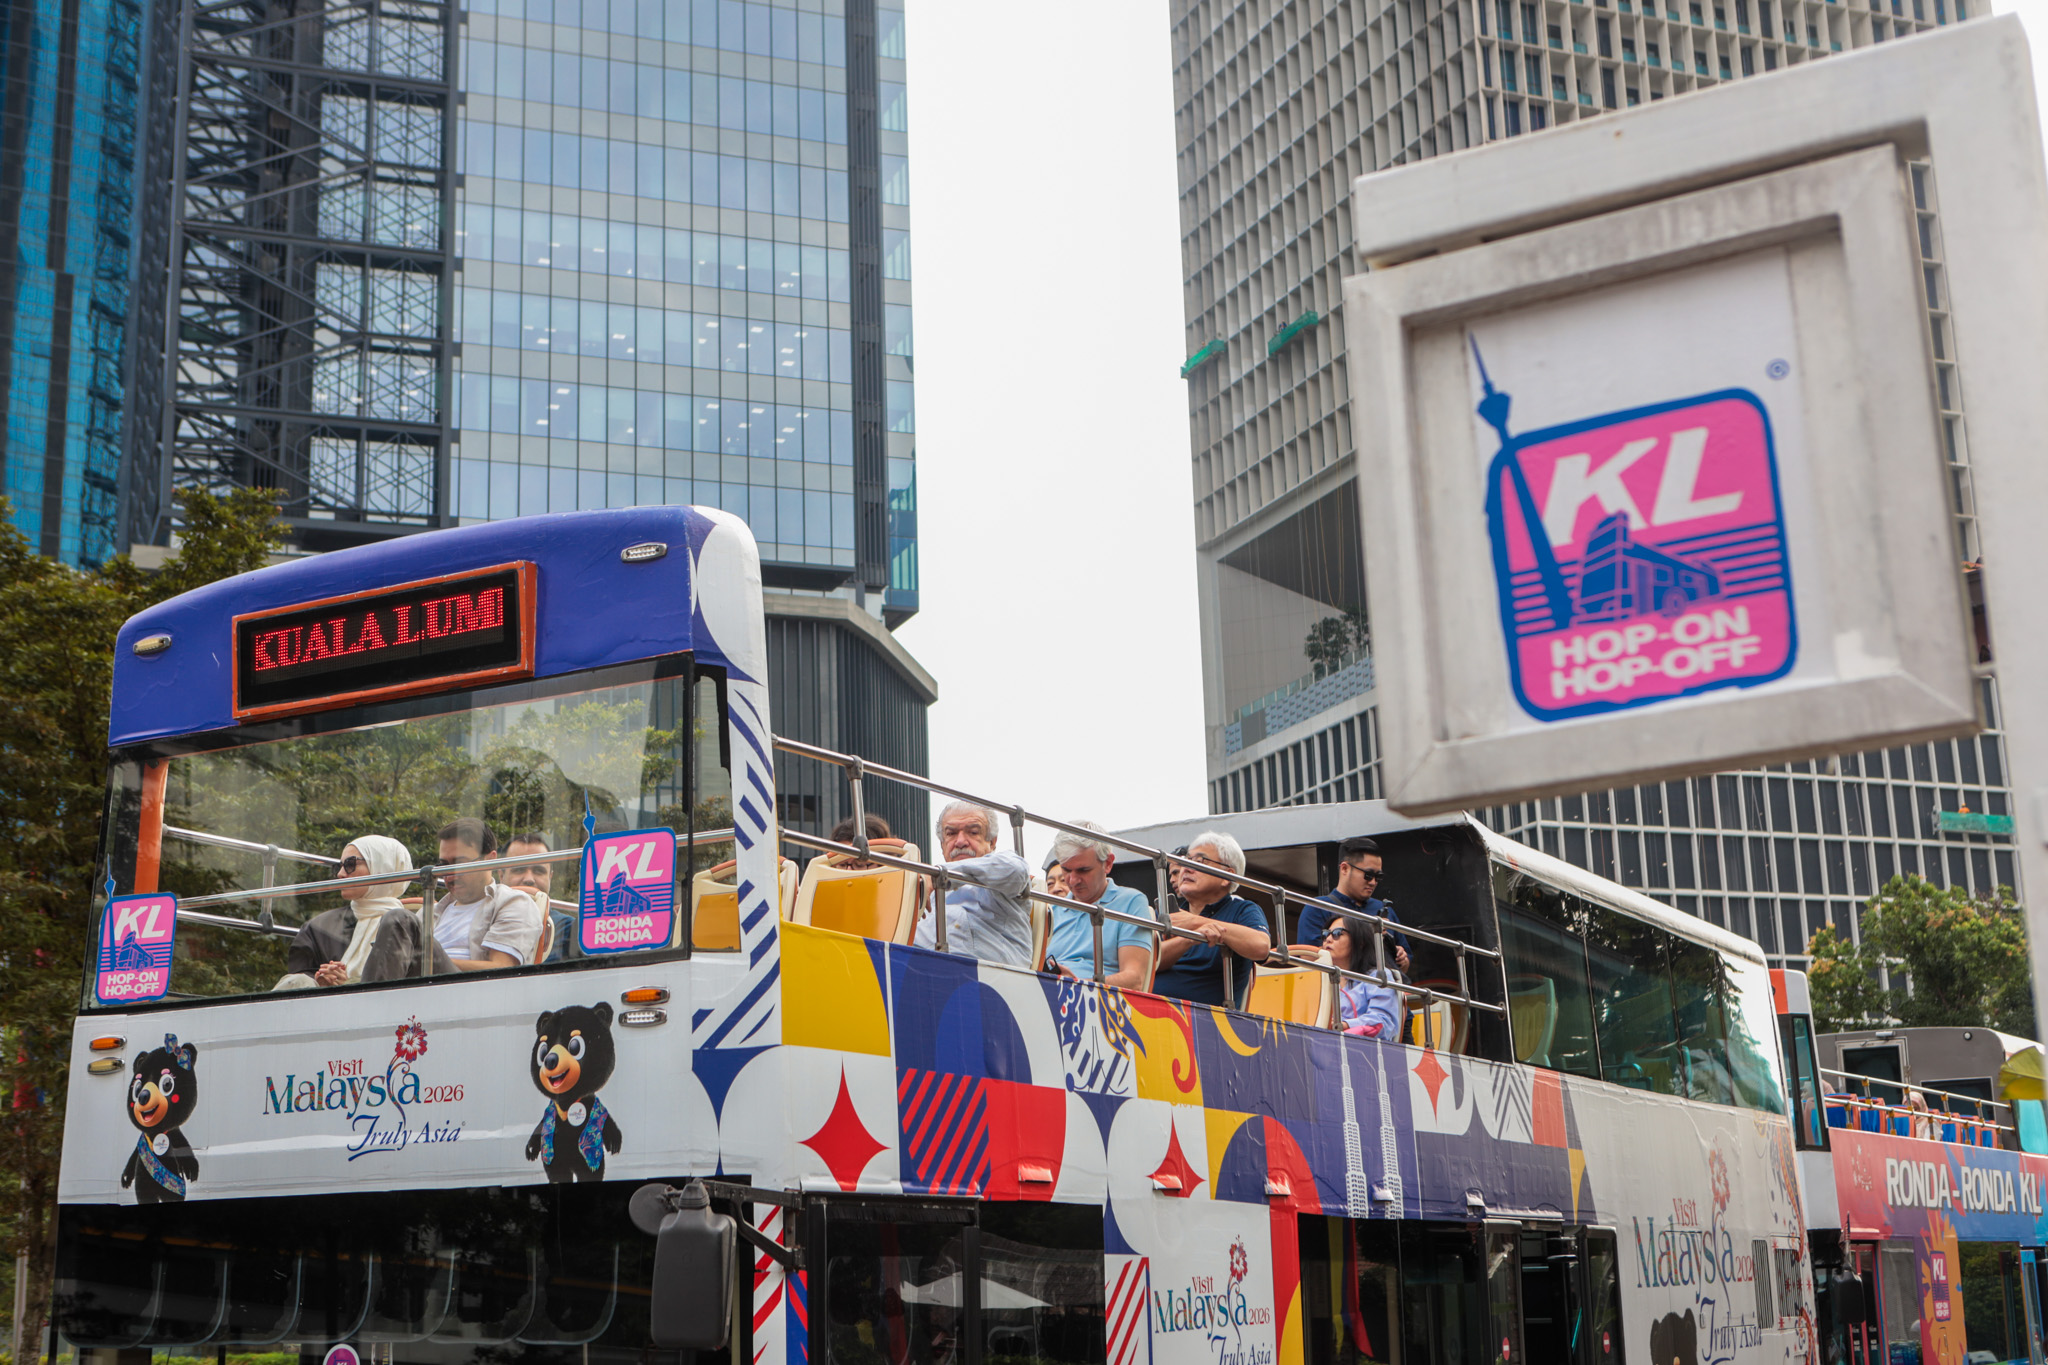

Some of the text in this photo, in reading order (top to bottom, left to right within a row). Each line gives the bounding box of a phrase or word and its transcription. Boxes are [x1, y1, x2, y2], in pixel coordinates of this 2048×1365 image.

[1541, 426, 1745, 548] KL
[255, 587, 504, 672] KUALA LUM
[1550, 604, 1751, 669] HOP-ON
[1550, 635, 1762, 700] HOP-OFF
[594, 841, 665, 884] KL
[114, 904, 167, 941] KL
[593, 928, 653, 945] RONDA
[594, 914, 653, 932] RONDA
[104, 982, 160, 997] HOP-OFF
[106, 970, 159, 986] HOP-ON
[327, 1058, 364, 1077] Visit
[262, 1067, 465, 1120] Malaysia 2026
[346, 1114, 461, 1156] Truly Asia
[1672, 1198, 1699, 1227] Visit
[2018, 1171, 2044, 1214] KL
[1632, 1214, 1756, 1305] Malaysia 202
[1932, 1257, 1947, 1281] KL
[1191, 1276, 1214, 1294] Visit
[1153, 1286, 1271, 1341] Malaysia 2026
[1700, 1296, 1763, 1363] Truly Asia
